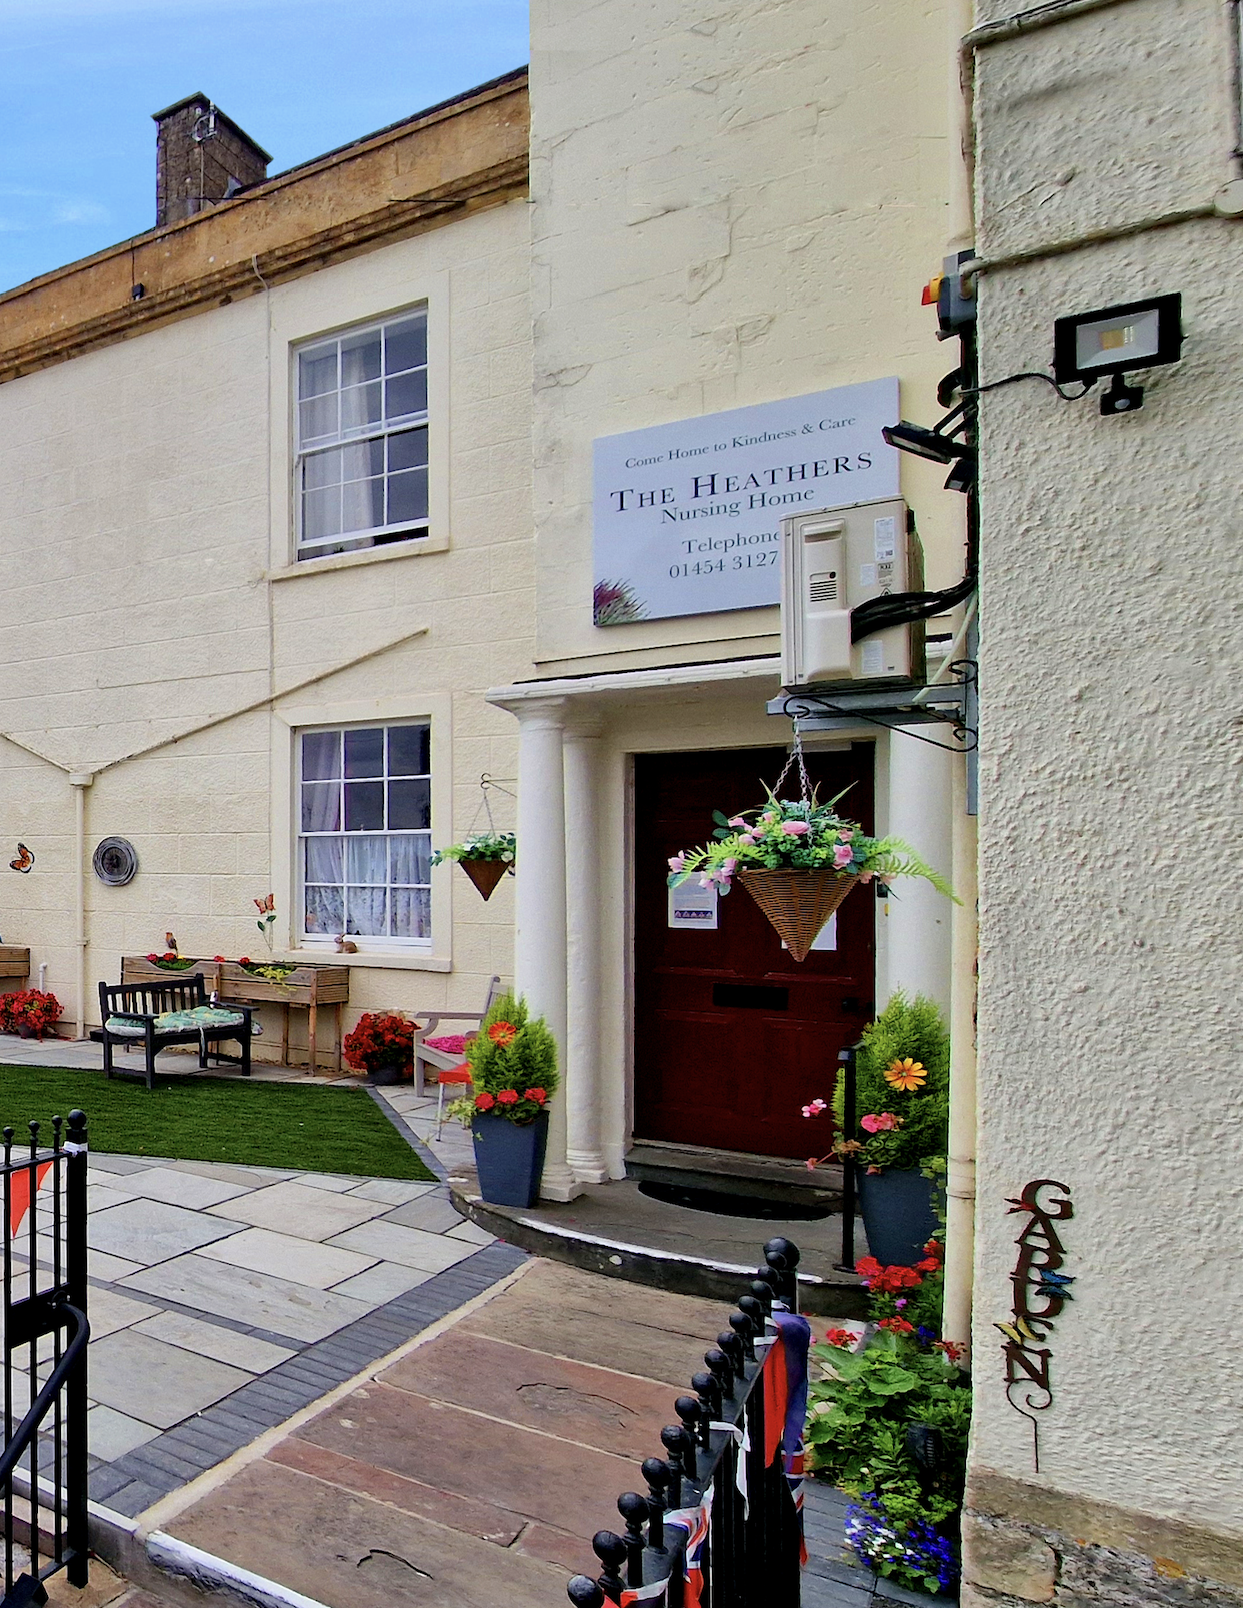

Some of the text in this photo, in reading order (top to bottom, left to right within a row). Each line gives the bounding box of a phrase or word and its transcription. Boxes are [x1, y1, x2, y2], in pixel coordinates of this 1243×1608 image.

[625, 417, 856, 469] Come Home to Kindness & Care
[609, 452, 872, 513] THE HEATHERS
[660, 489, 815, 524] Nursing Home
[669, 550, 778, 579] 01454 3127
